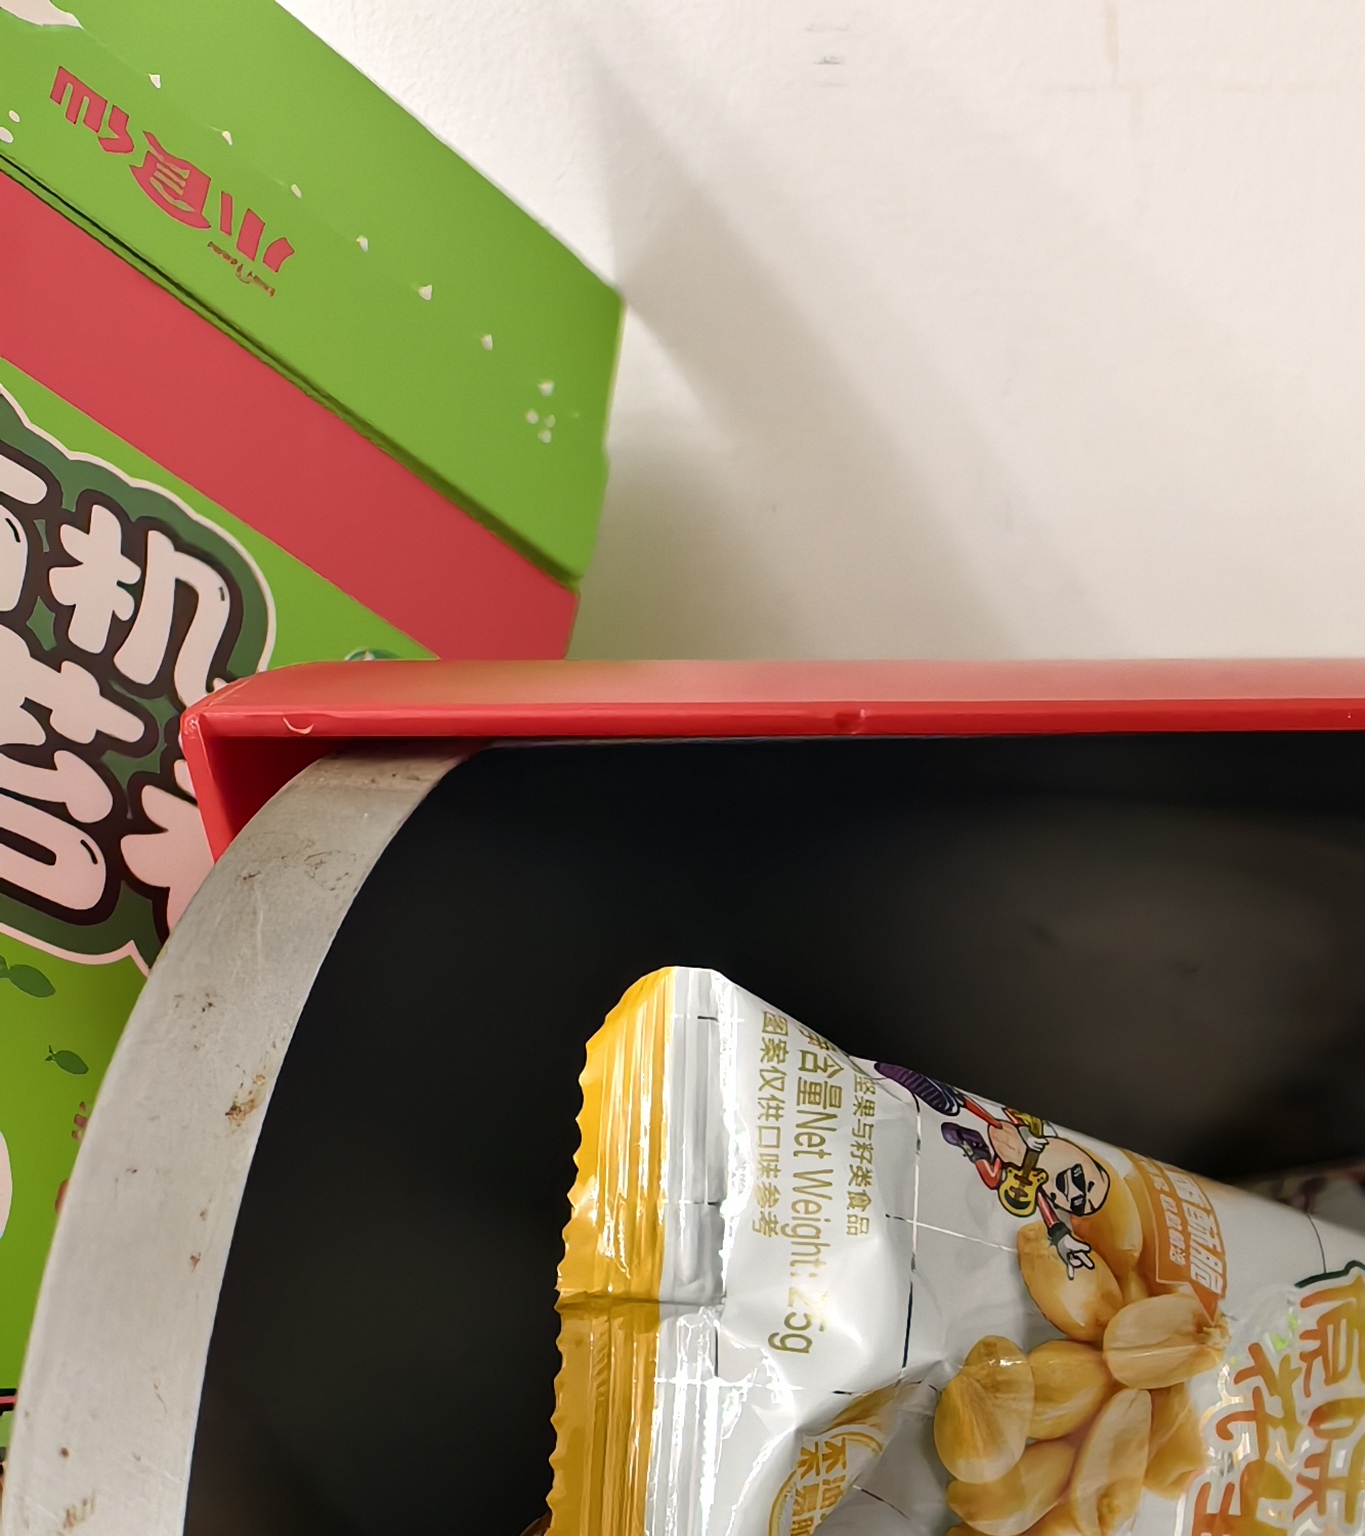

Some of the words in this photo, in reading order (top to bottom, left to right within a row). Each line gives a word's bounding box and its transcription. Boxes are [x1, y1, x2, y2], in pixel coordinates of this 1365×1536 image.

[750, 1010, 789, 1239] 图案仅供口味参考
[768, 1292, 829, 1356] 25g
